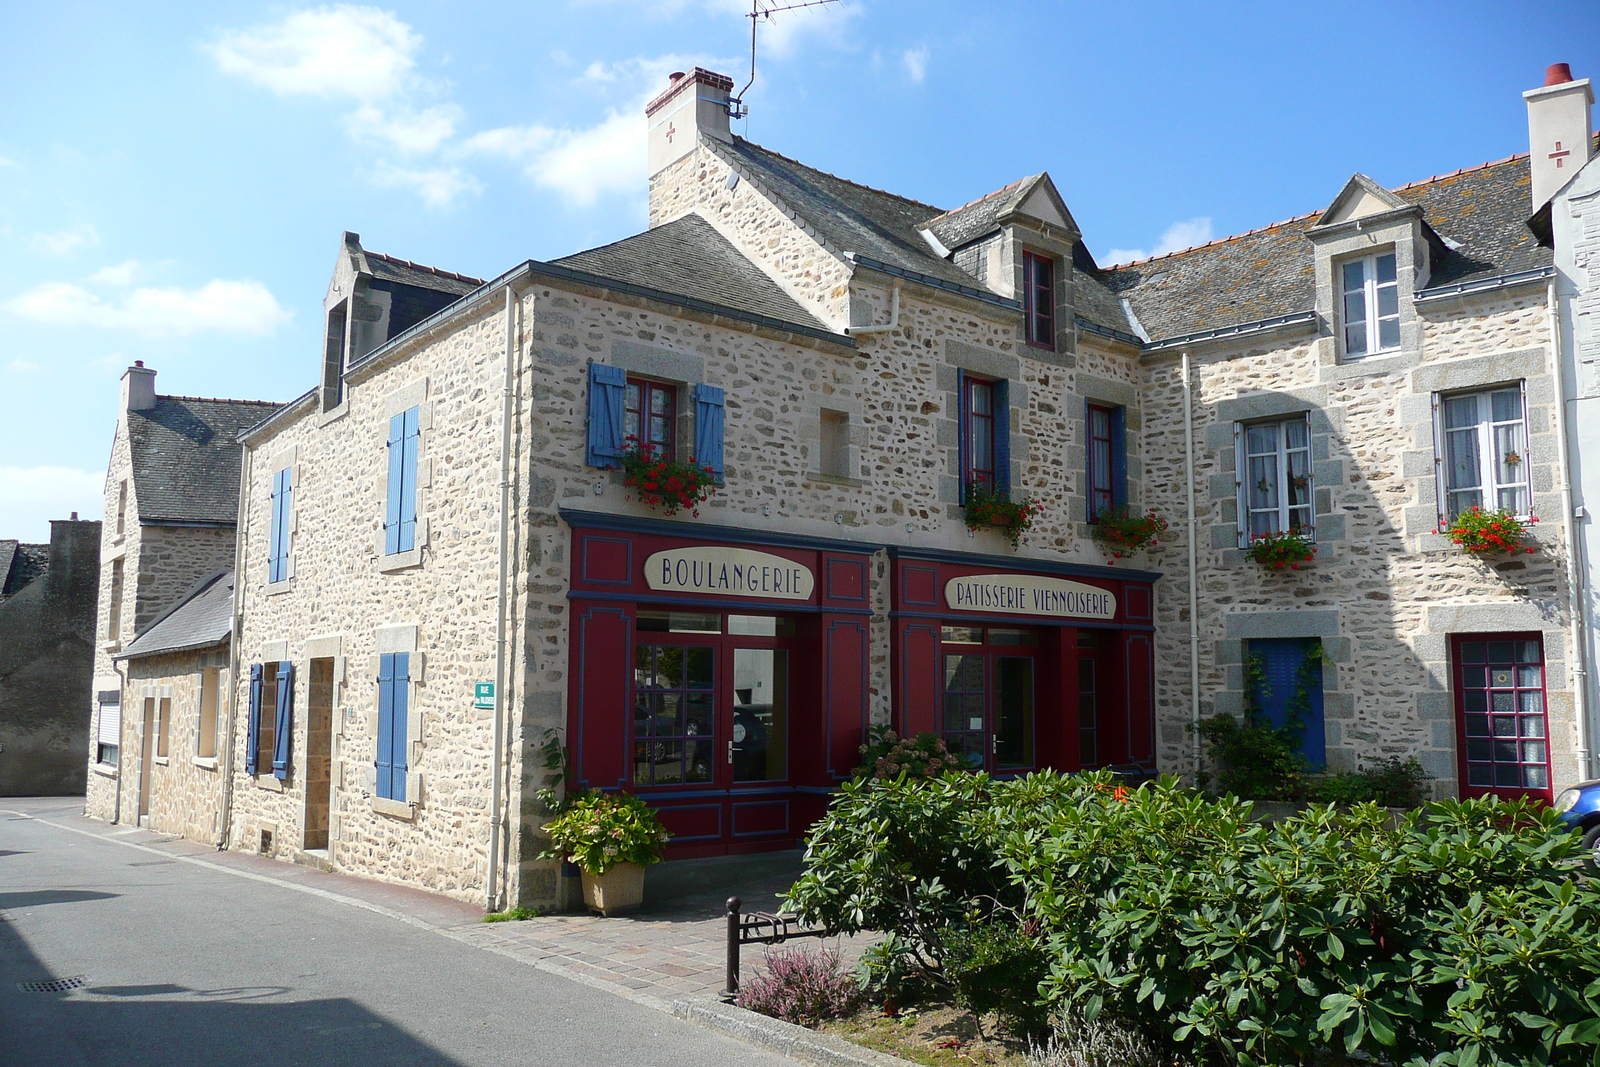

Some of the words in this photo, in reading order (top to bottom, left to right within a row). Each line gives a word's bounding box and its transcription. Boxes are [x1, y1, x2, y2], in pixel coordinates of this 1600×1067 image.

[662, 558, 801, 594] BOULANGERIE
[957, 582, 1026, 609] PATISSERIE
[1033, 588, 1109, 615] VIENNOISERIE
[480, 685, 490, 694] RUE
